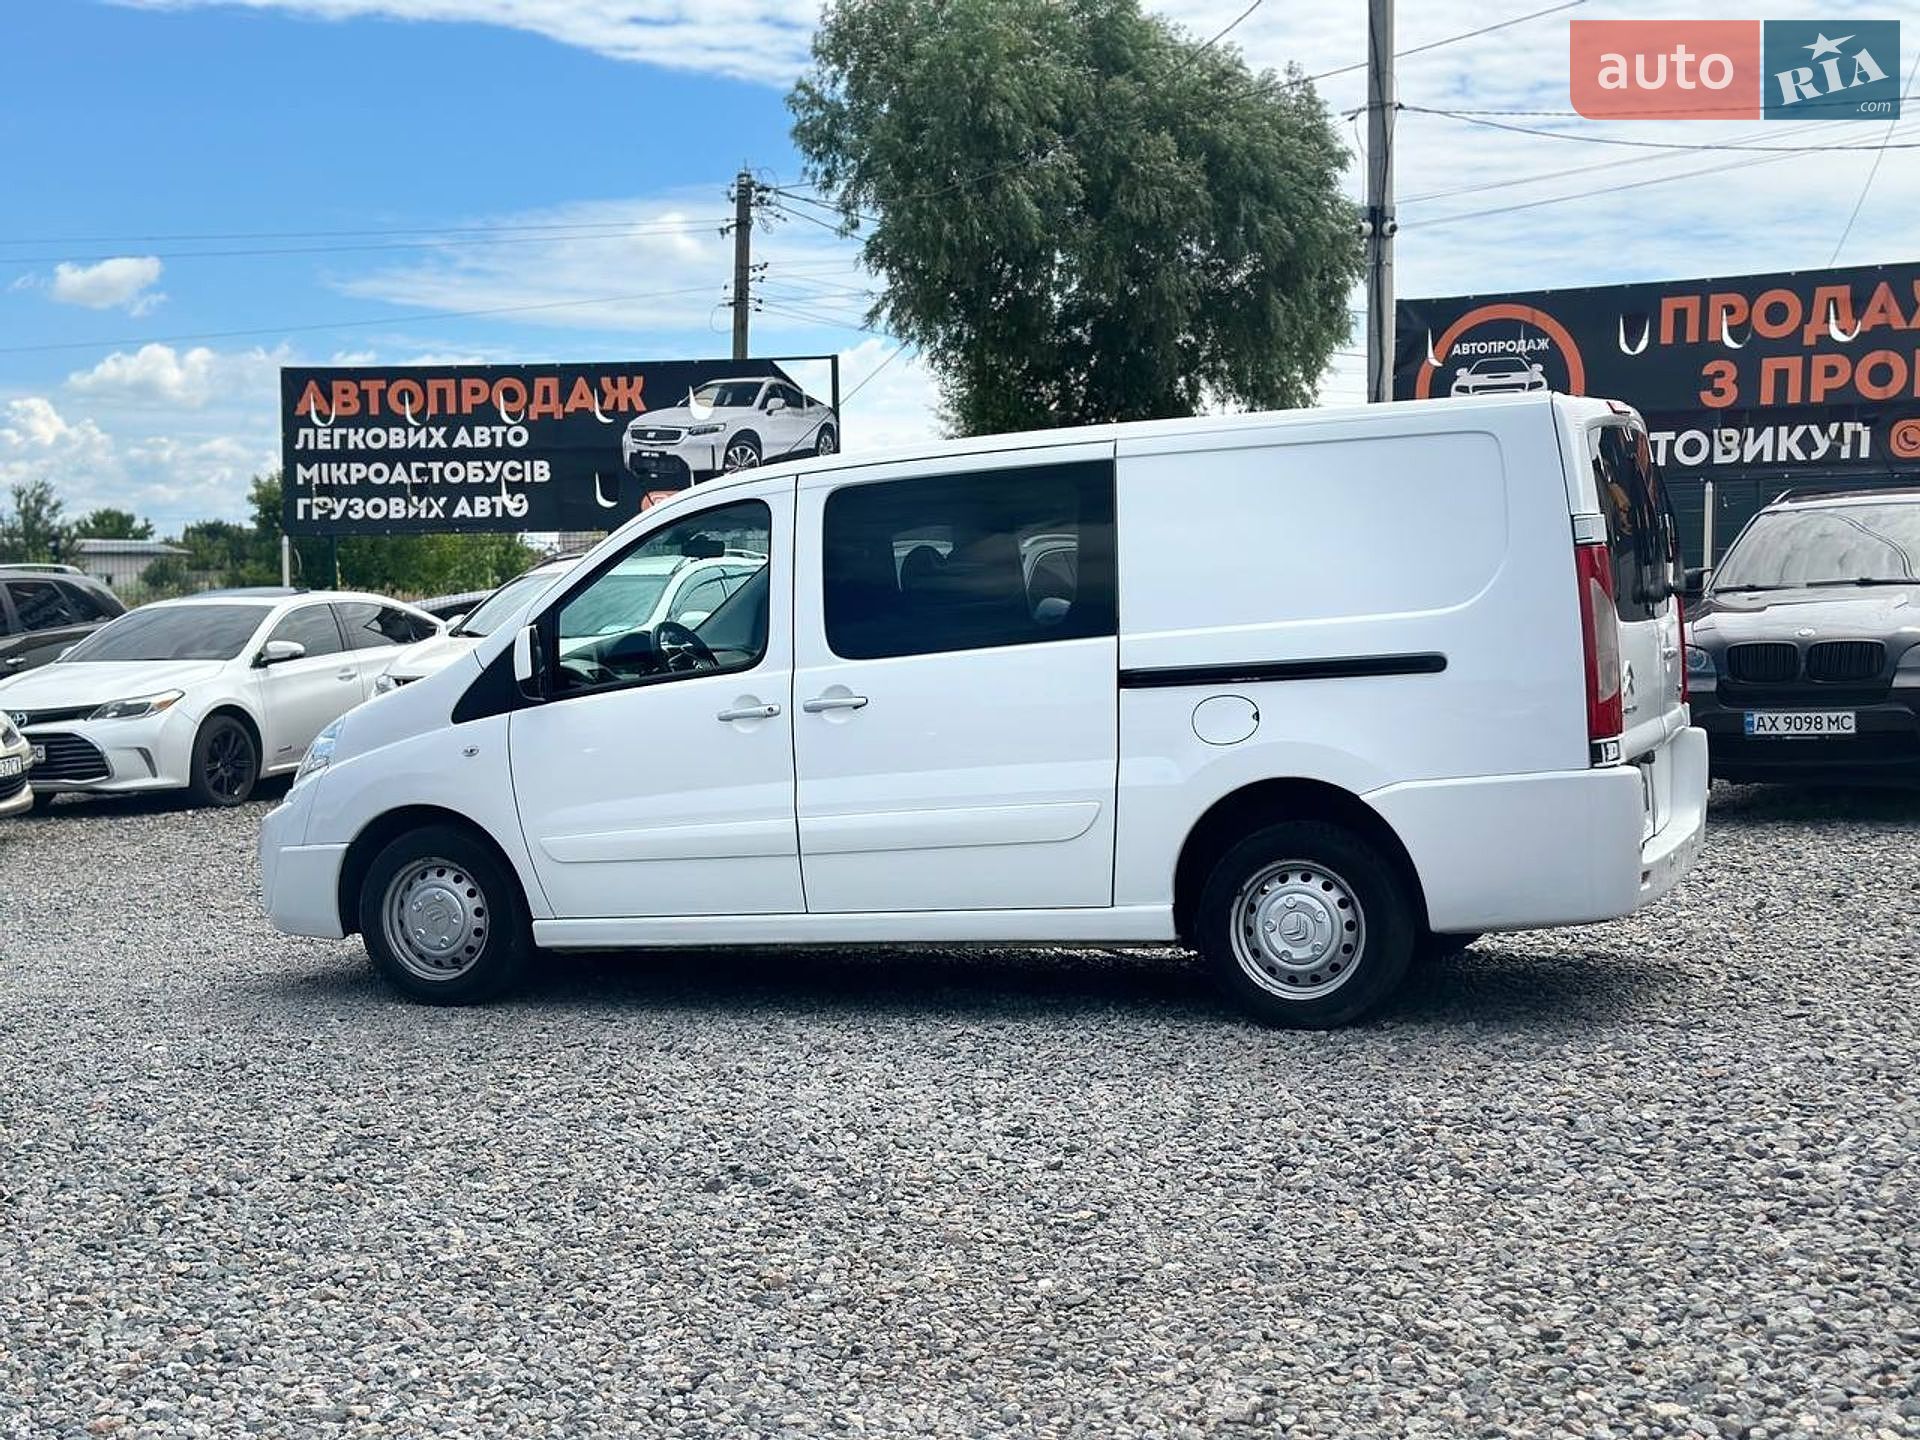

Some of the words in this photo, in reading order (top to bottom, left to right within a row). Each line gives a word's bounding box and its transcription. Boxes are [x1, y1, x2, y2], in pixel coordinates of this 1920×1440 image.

[1452, 337, 1550, 355] АВТОПРОДАЖ
[1759, 348, 1920, 406] ПРО
[295, 376, 647, 420] АВТОПРОДАЖ
[295, 426, 448, 450] ЛЕГКОВИХ
[452, 425, 529, 448] АВТО
[1648, 421, 1870, 467] ТОВИКУП
[296, 496, 447, 520] ГРУЗОВИХ
[452, 493, 529, 518] АВТО
[1756, 716, 1779, 732] AX
[1783, 715, 1823, 732] 9098
[1827, 715, 1853, 731] MC
